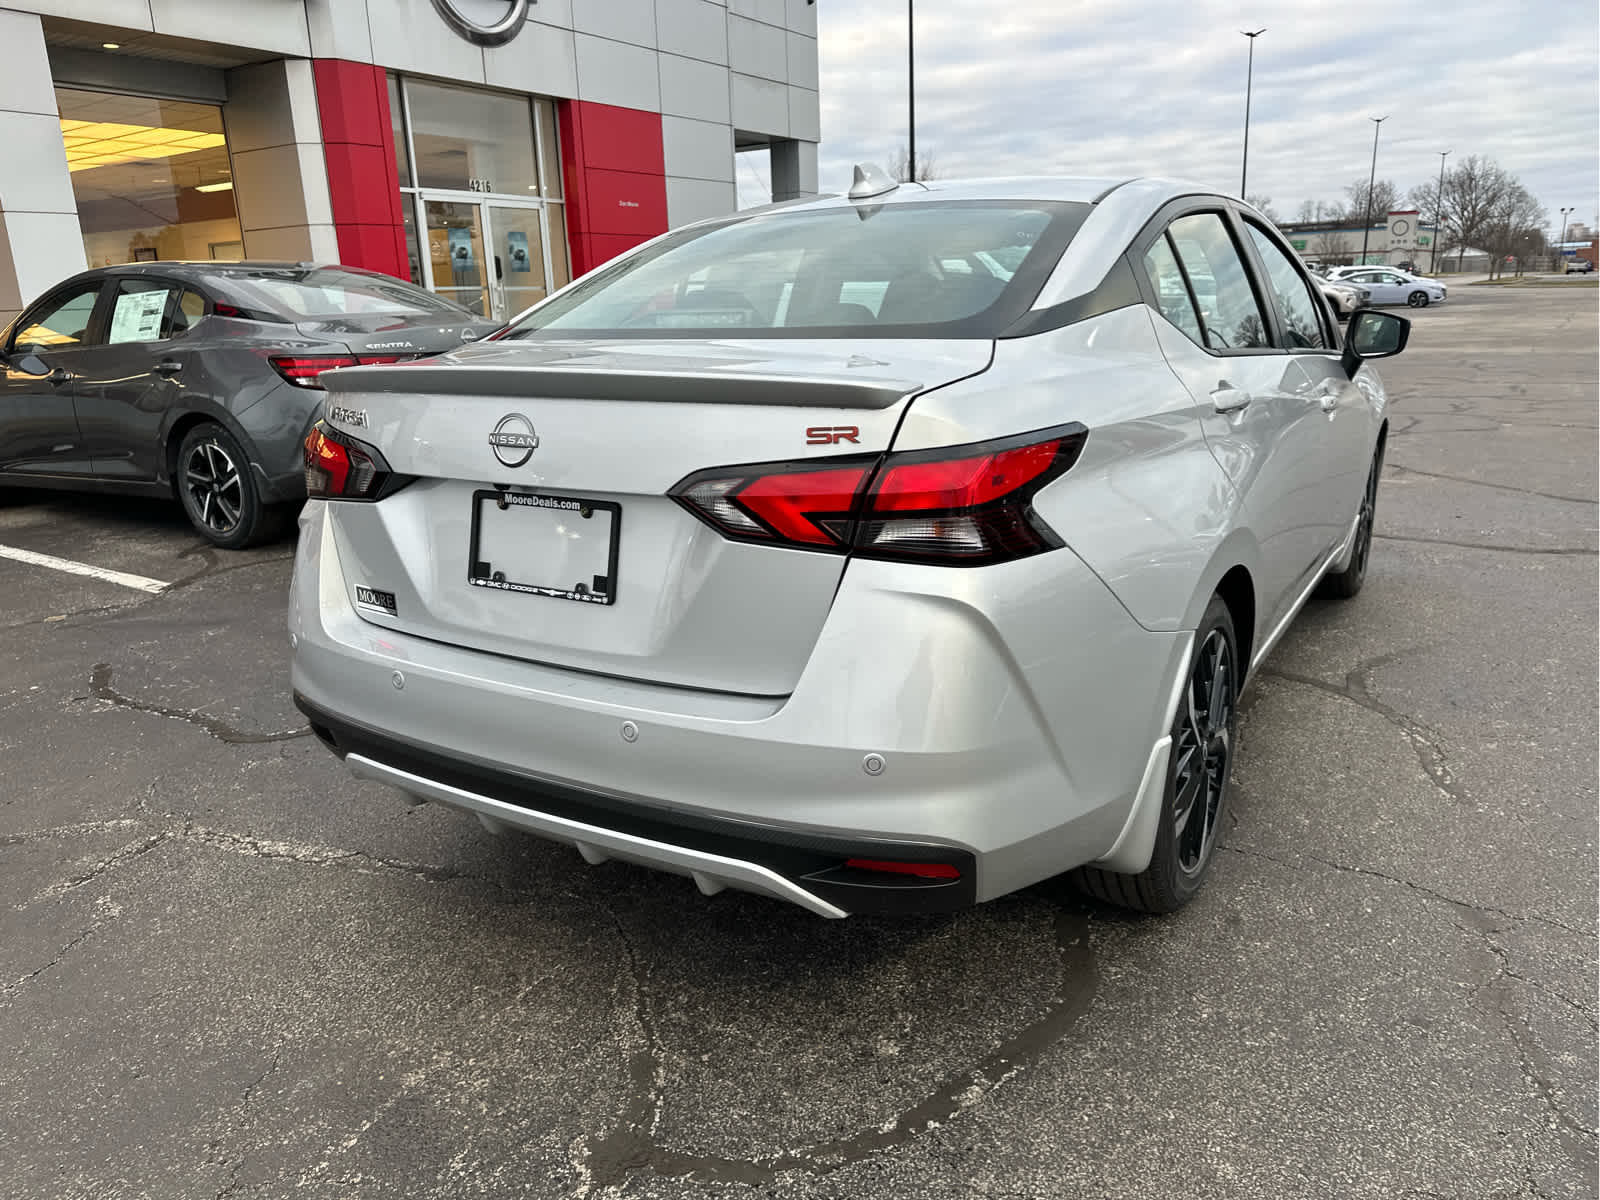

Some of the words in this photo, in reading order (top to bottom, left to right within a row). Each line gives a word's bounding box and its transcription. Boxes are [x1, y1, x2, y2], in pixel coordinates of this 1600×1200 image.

[470, 180, 491, 192] 4216
[366, 341, 413, 349] SENTRA
[490, 434, 537, 447] NISSAN
[806, 426, 860, 444] SR
[504, 493, 581, 510] MooreDeals.com
[358, 588, 394, 608] MOORE
